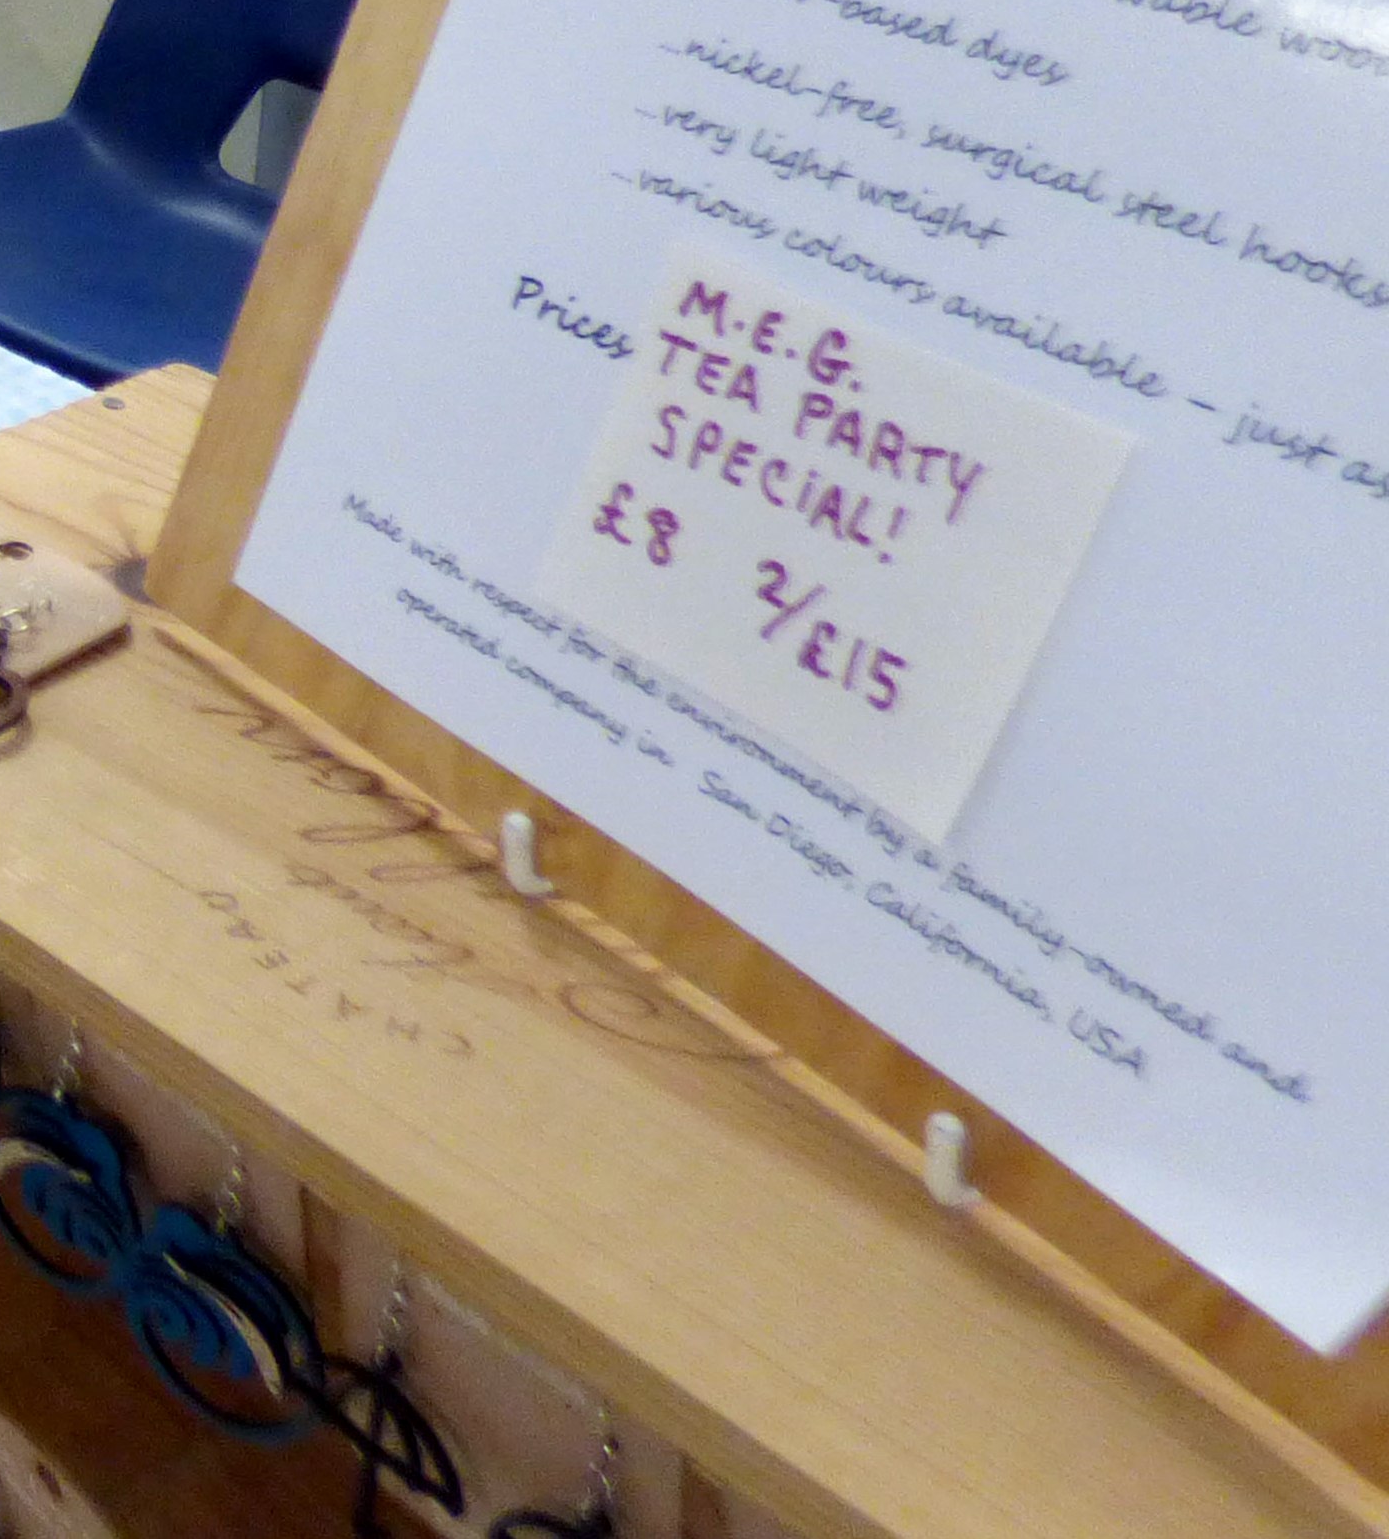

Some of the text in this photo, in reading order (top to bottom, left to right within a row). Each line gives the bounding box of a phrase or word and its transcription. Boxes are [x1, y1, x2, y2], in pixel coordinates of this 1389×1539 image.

[966, 30, 1069, 87] dyes
[749, 127, 854, 191] light
[857, 178, 1009, 250] weight
[920, 122, 1106, 205] surgical
[1113, 189, 1228, 246] steel
[512, 274, 635, 360] Prices
[678, 280, 863, 394] M.E.G.
[784, 234, 938, 306] colours
[942, 294, 1169, 398] available
[1222, 400, 1339, 469] just
[659, 329, 987, 526] TEA PARTY
[591, 481, 681, 567] £8
[343, 493, 1315, 1105] Made with respect for the environment by a family-owned and
[395, 586, 502, 661] operated
[504, 657, 628, 746] company
[636, 727, 674, 769] in
[696, 768, 761, 823] San
[1067, 1005, 1151, 1080] USA
